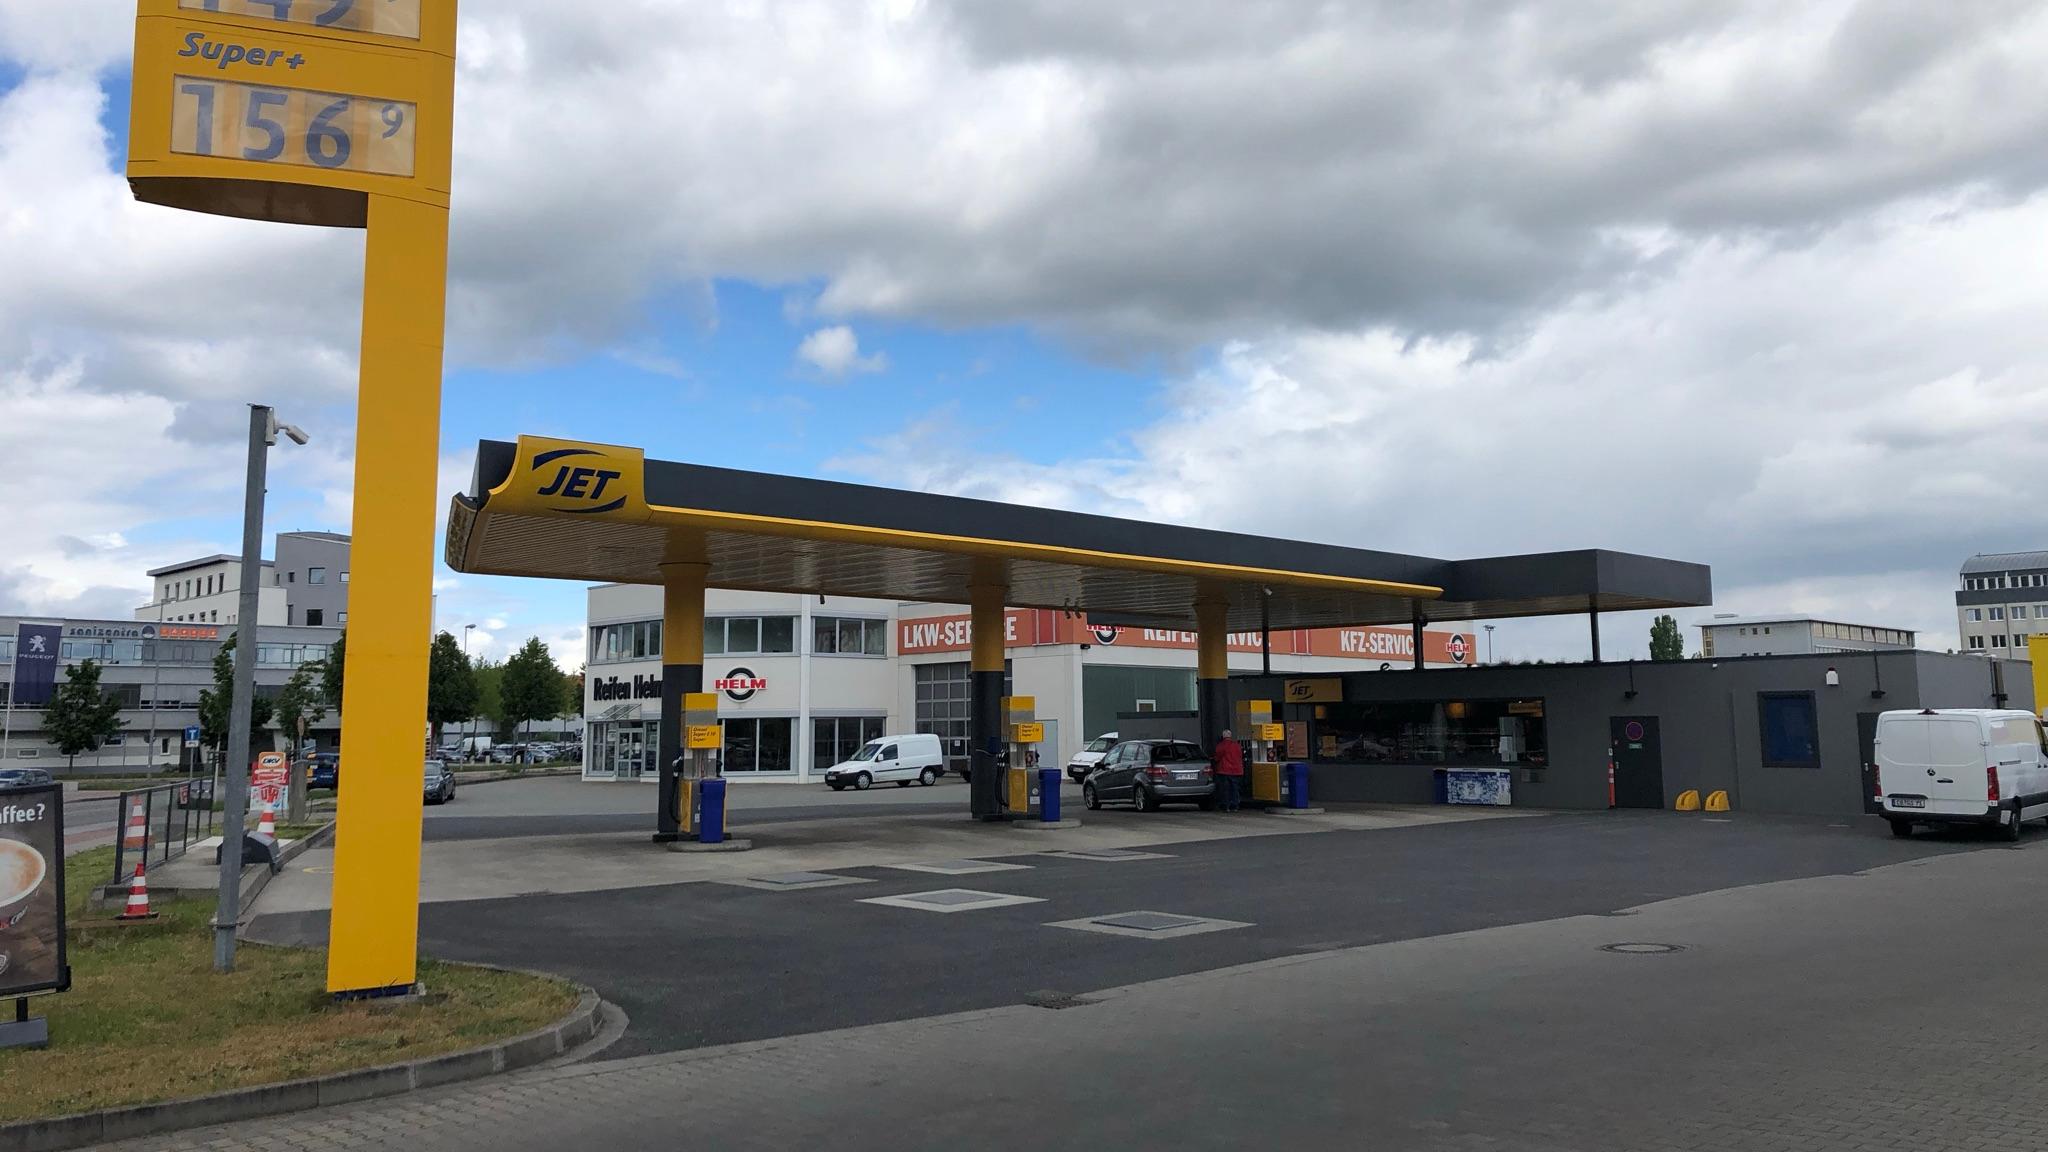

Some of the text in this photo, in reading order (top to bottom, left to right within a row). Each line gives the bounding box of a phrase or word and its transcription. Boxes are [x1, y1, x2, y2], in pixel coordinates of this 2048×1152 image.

[178, 32, 305, 70] Super+
[536, 466, 622, 500] JET
[1340, 630, 1414, 656] KFZ-SERVIC
[1447, 644, 1470, 653] HELM
[593, 676, 631, 701] Reifen
[715, 679, 767, 689] HELM
[1292, 686, 1311, 695] JET
[0, 802, 46, 825] ffee?
